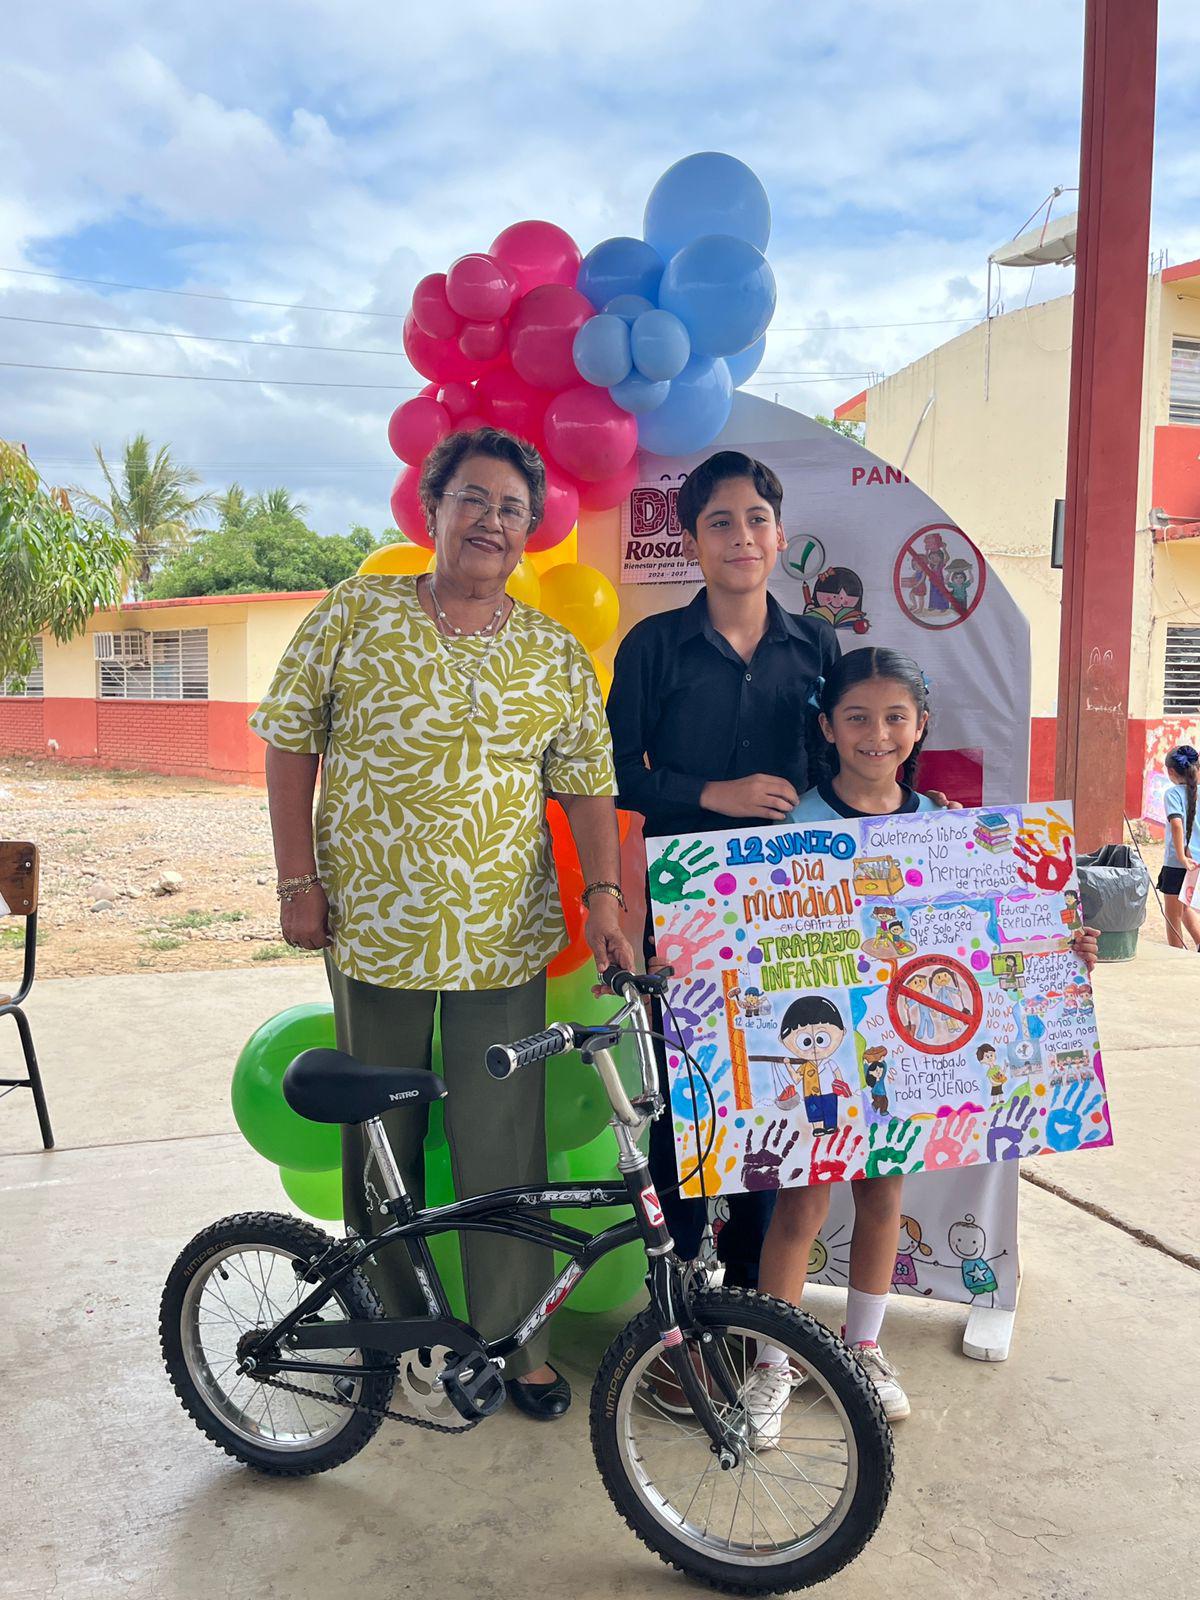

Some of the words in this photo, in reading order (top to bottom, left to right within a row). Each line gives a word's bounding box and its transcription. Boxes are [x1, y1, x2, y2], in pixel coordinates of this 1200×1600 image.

[625, 540, 684, 561] Rosa
[624, 562, 656, 570] Bienestar
[657, 562, 675, 571] para
[871, 829, 933, 848] Queremos
[937, 826, 968, 841] libros
[726, 838, 765, 866] 12
[765, 829, 857, 865] JUNIO
[928, 845, 949, 860] NO
[792, 858, 825, 884] Dia
[955, 880, 969, 890] de
[973, 876, 1016, 890] trabajo
[1000, 903, 1031, 916] Educar
[1034, 903, 1049, 912] no
[780, 922, 794, 932] en
[837, 915, 851, 929] del
[757, 929, 861, 963] TRABAJO
[761, 954, 862, 992] INFANTIL
[1066, 960, 1078, 969] es
[756, 1017, 778, 1030] Junio
[866, 1014, 885, 1031] NO
[881, 1029, 896, 1042] NO
[901, 1056, 918, 1073] El
[923, 1053, 967, 1071] trabajo
[894, 1086, 922, 1102] roba
